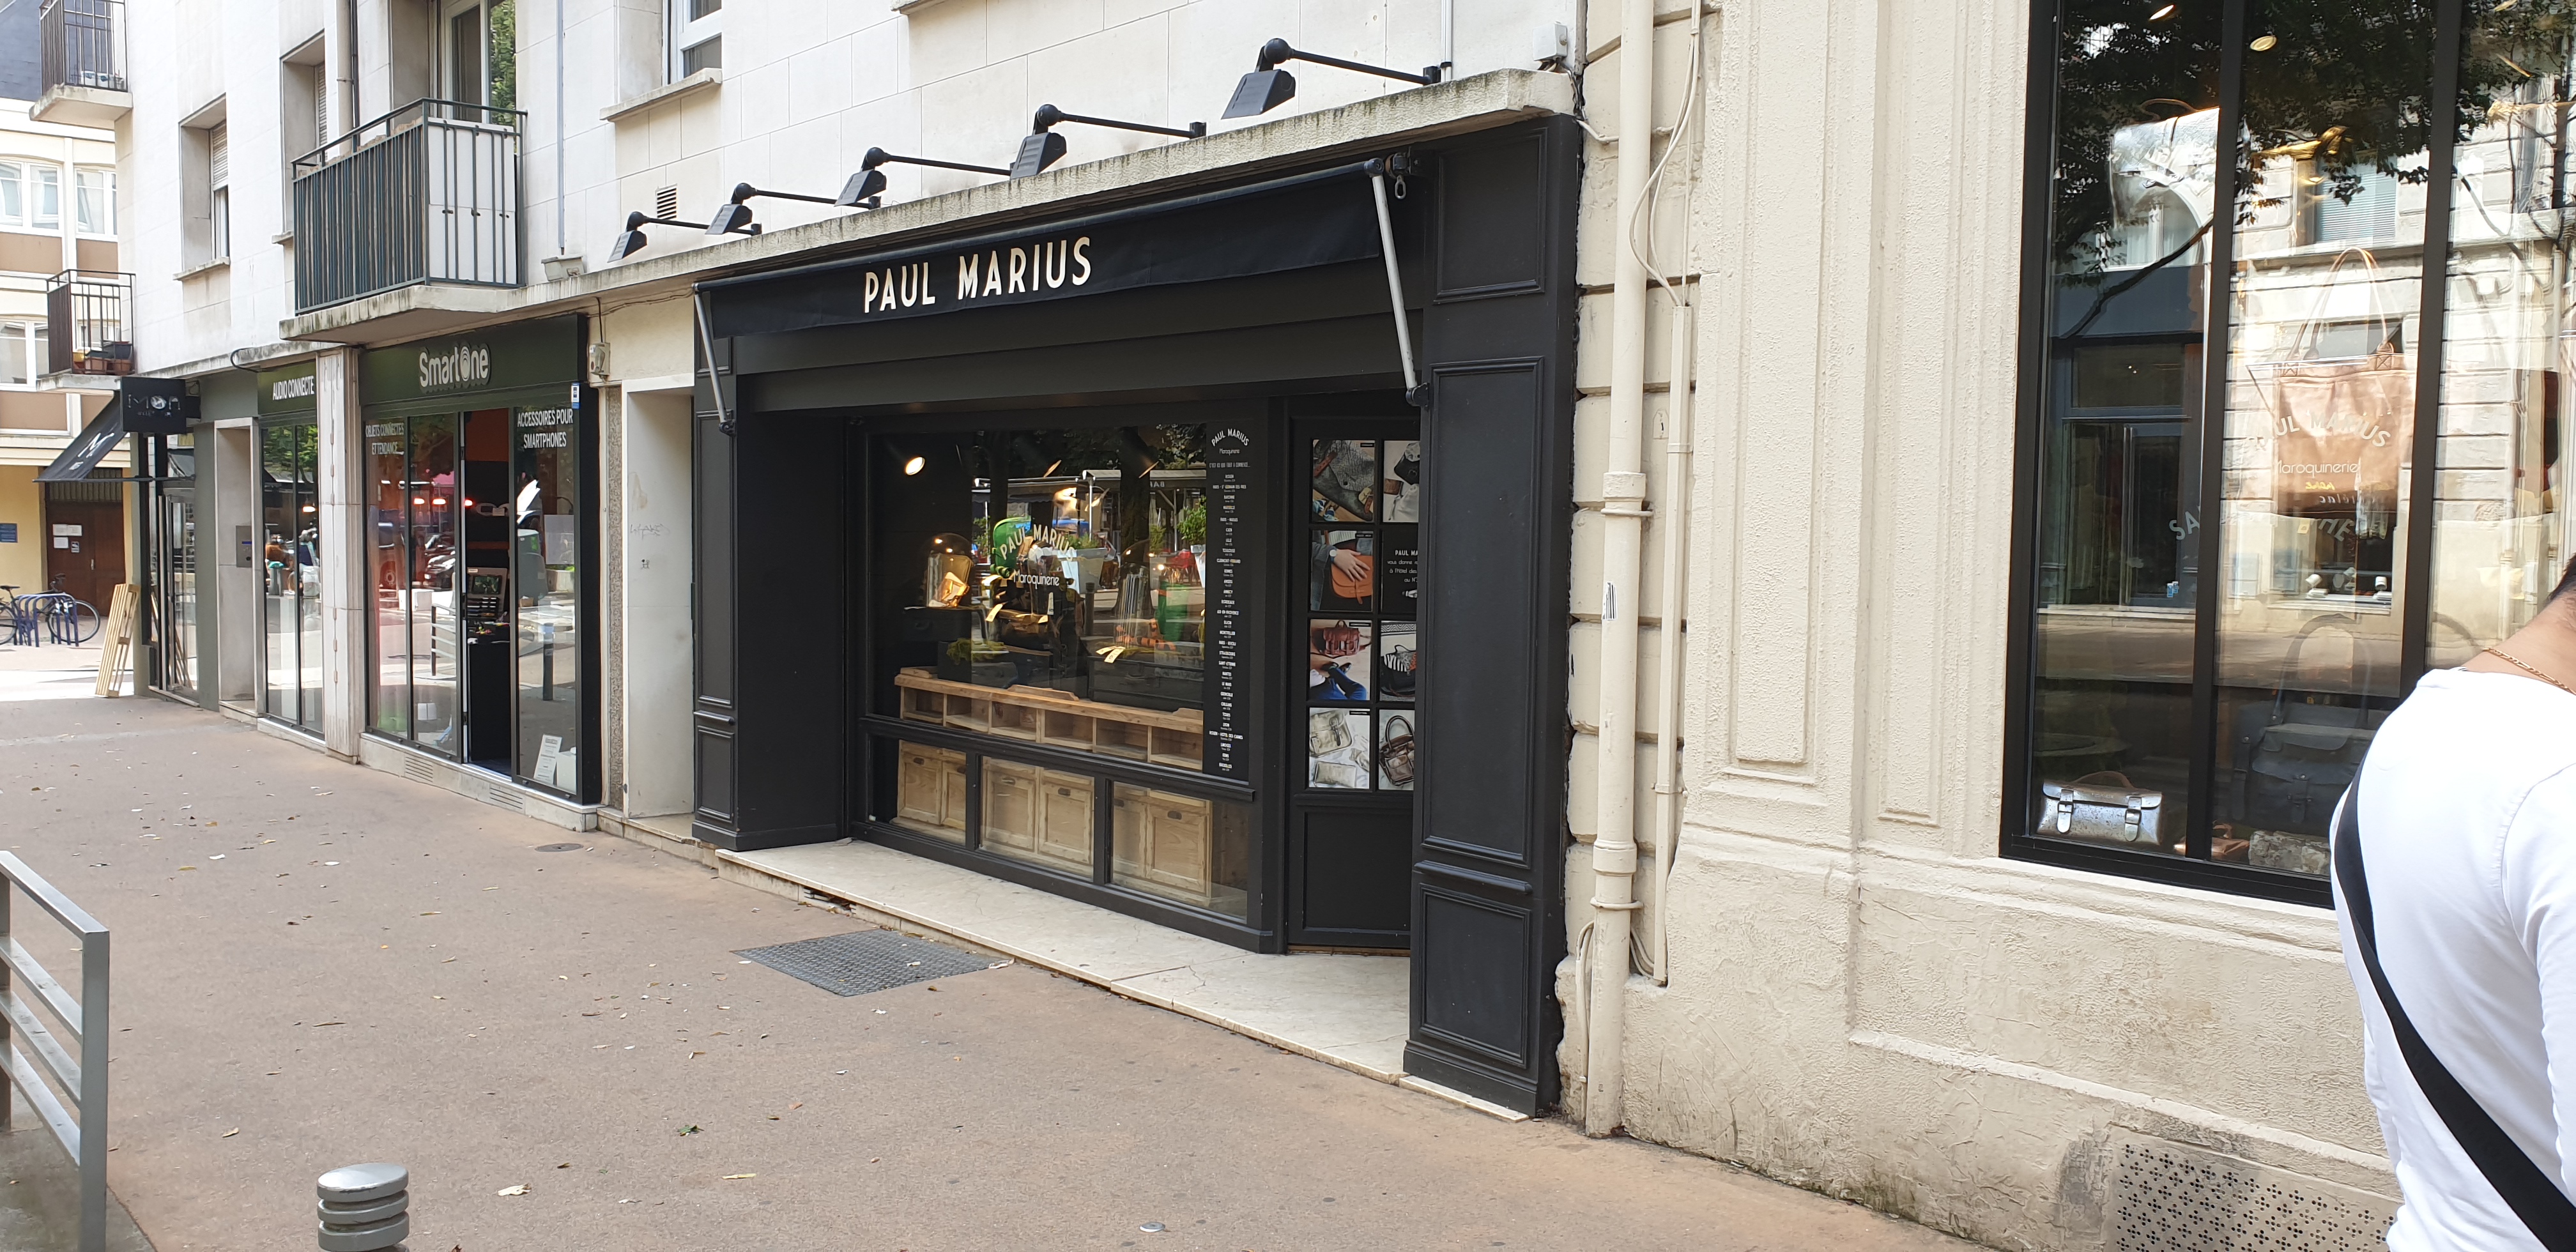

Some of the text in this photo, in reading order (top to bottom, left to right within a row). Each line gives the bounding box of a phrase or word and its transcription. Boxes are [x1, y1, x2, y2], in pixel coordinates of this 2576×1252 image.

[864, 237, 1091, 313] PAUL MARIUS
[419, 346, 489, 387] SmartOne
[273, 380, 288, 401] AUDIO
[518, 408, 573, 427] ACCESSOIRES POUR
[524, 431, 567, 448] SMARTPHONES
[1211, 428, 1250, 447] PAUL MARIUS
[2310, 411, 2391, 447] MARIUS
[999, 524, 1076, 563] PAUL MARIUS
[1013, 569, 1060, 590] Maroquinerie
